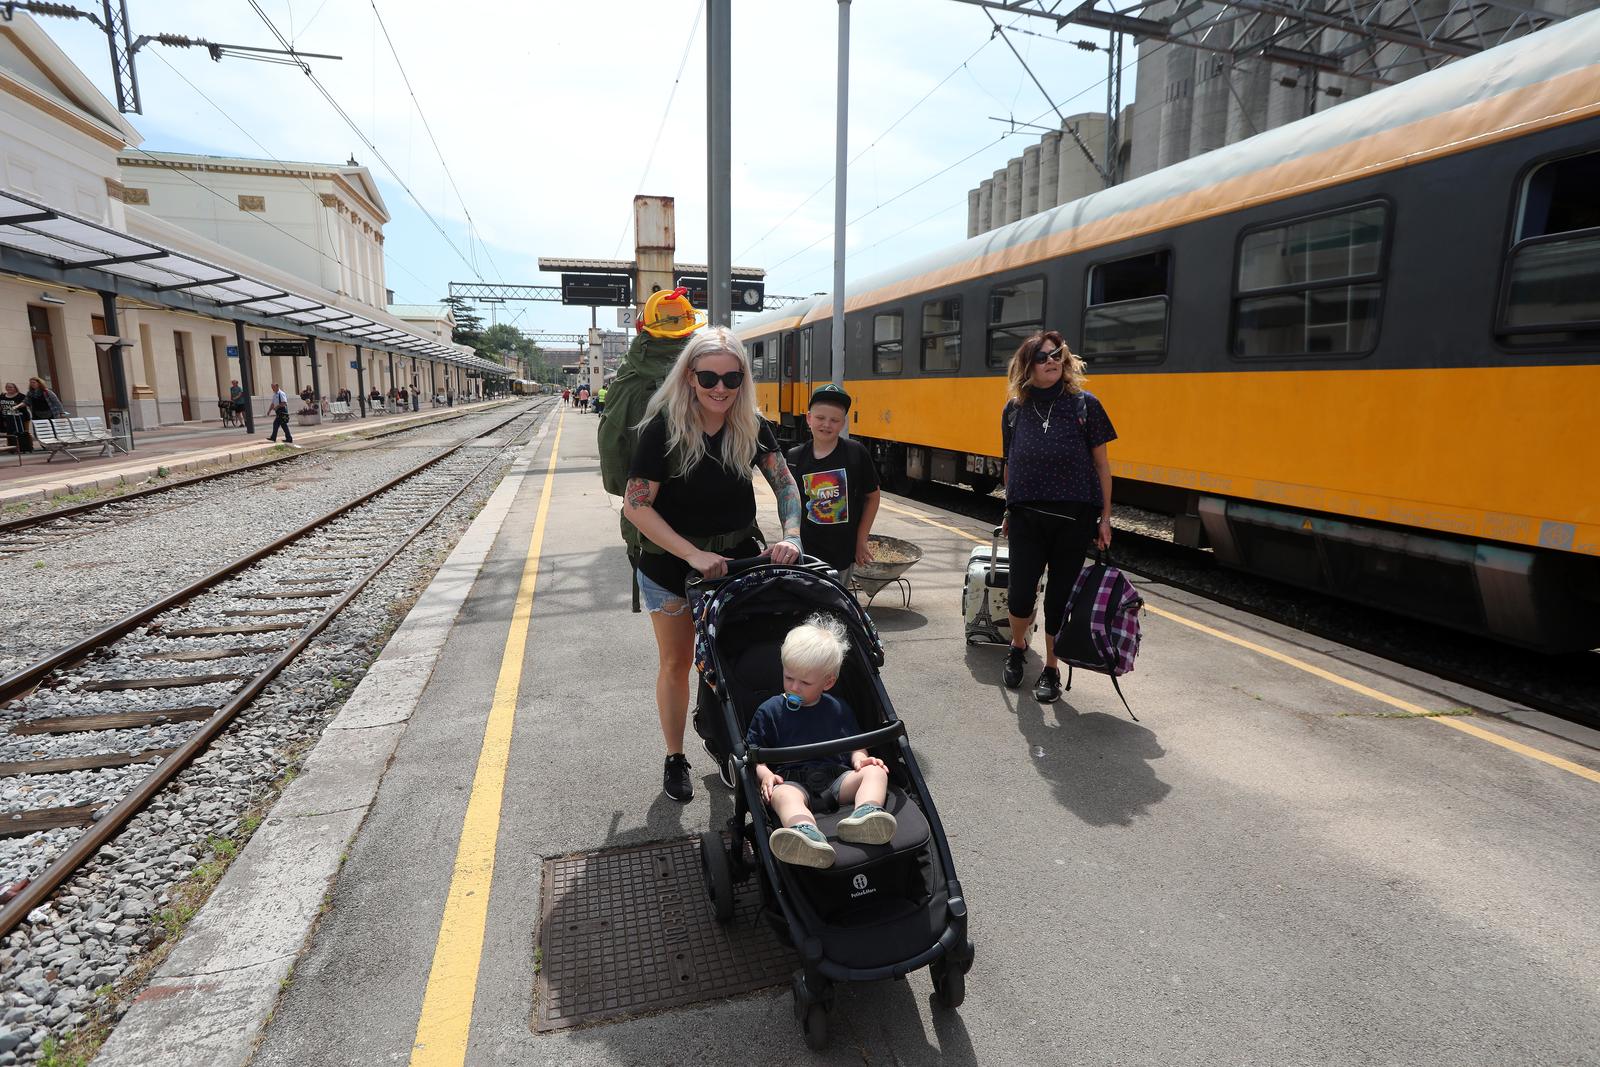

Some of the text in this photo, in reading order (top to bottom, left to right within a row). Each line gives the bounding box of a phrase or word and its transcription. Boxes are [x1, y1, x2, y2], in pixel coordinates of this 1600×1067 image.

[623, 312, 631, 324] 2
[810, 485, 840, 499] VANS
[657, 885, 690, 946] TELEFON
